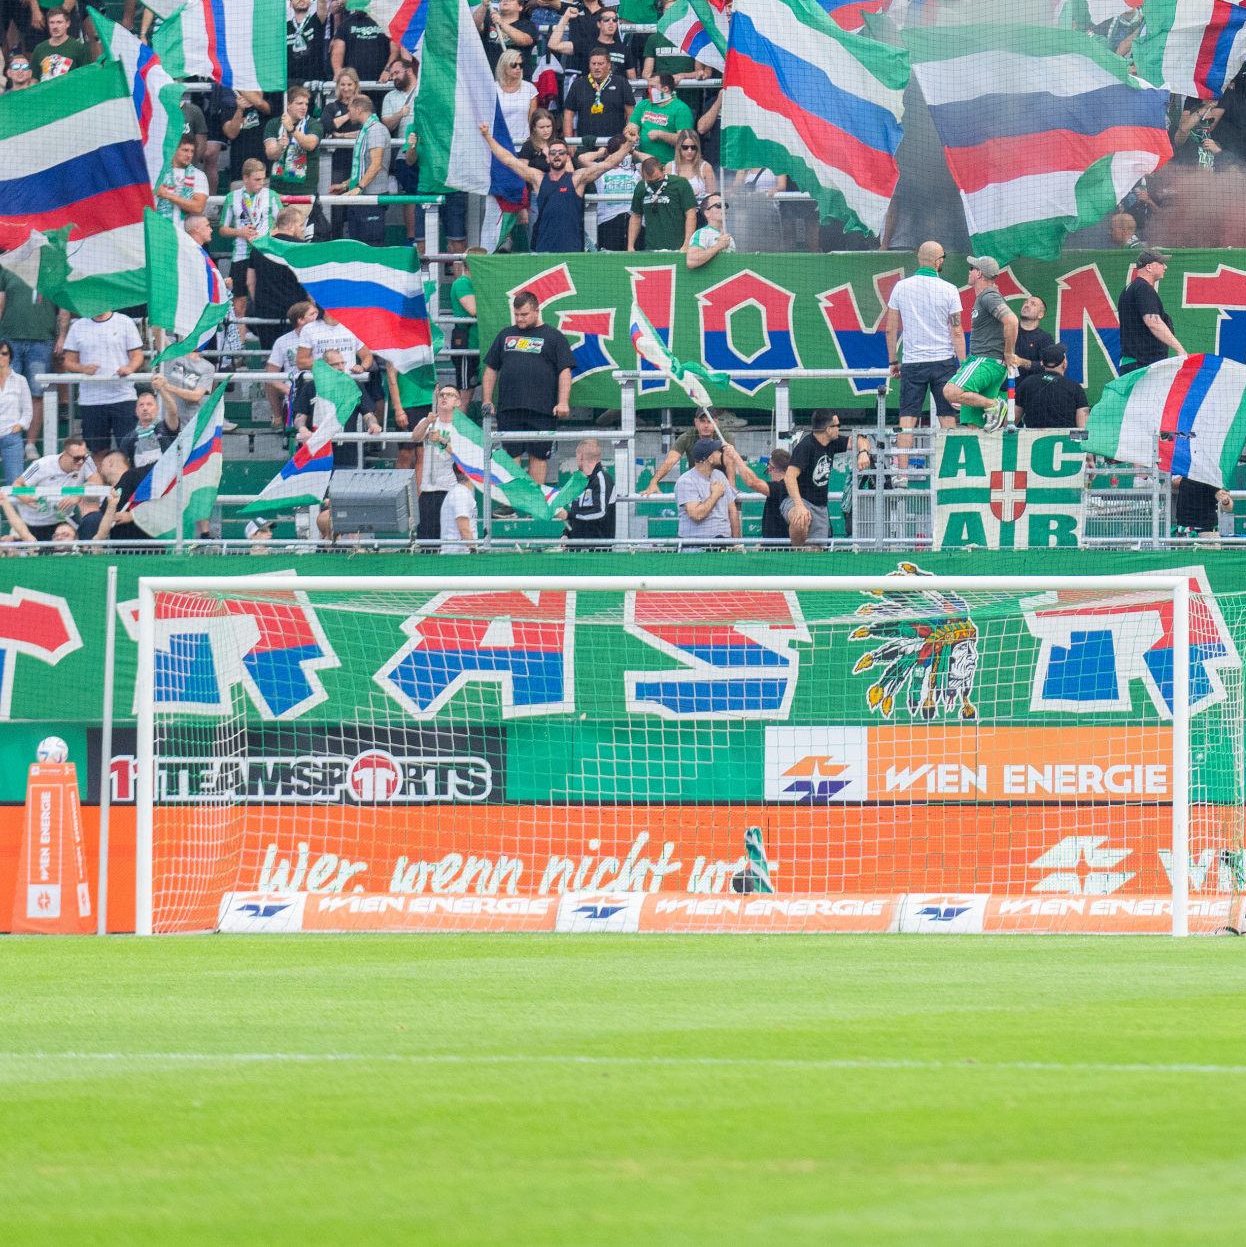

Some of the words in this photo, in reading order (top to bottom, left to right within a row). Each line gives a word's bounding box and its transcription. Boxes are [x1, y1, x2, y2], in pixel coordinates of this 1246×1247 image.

[885, 764, 987, 794] WIEN
[1003, 764, 1168, 794] ENERGIE
[40, 791, 51, 844] ENERGIE
[40, 848, 51, 881] WIEN
[389, 853, 520, 893] wenn
[538, 831, 683, 893] nicht
[318, 896, 410, 914] WIEN
[417, 897, 556, 915] ENERGIE
[655, 897, 744, 915] WIEN
[744, 897, 890, 916] ENERGIE
[999, 897, 1090, 915] WIEN
